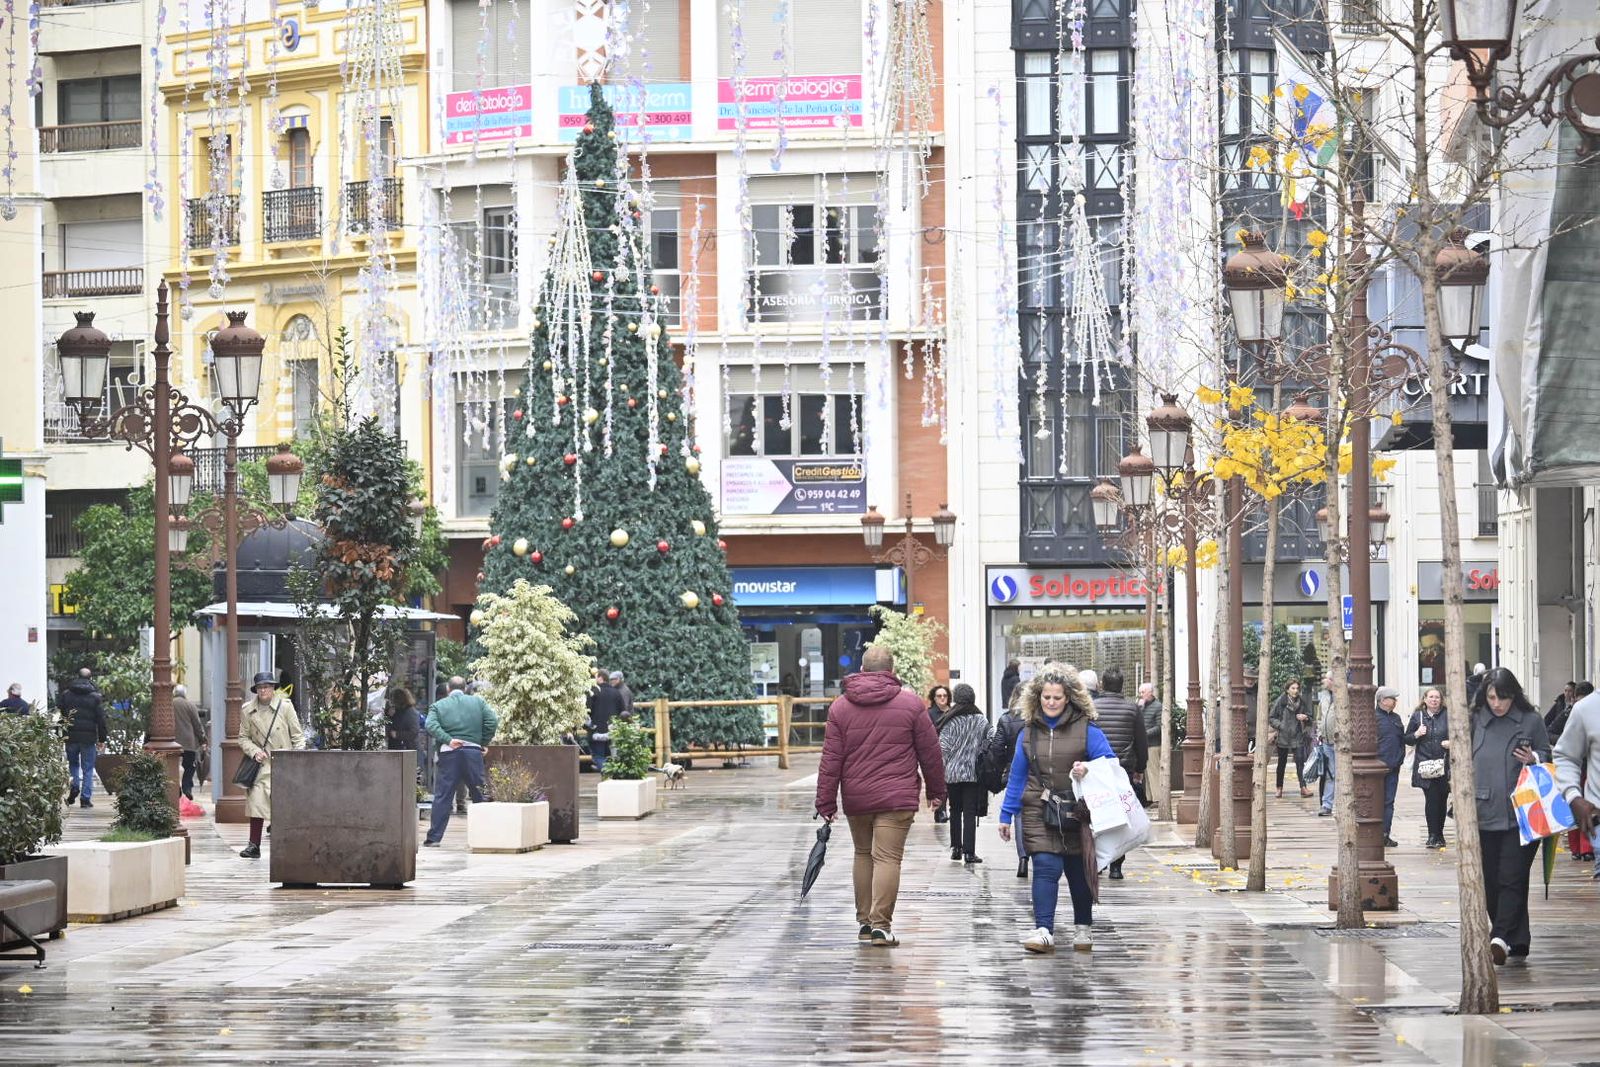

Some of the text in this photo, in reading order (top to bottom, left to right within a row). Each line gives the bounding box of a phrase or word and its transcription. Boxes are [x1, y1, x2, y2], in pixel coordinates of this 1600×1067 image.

[1403, 372, 1486, 396] CRT
[807, 489, 861, 499] 959 04 42 49
[734, 580, 797, 594] movistar
